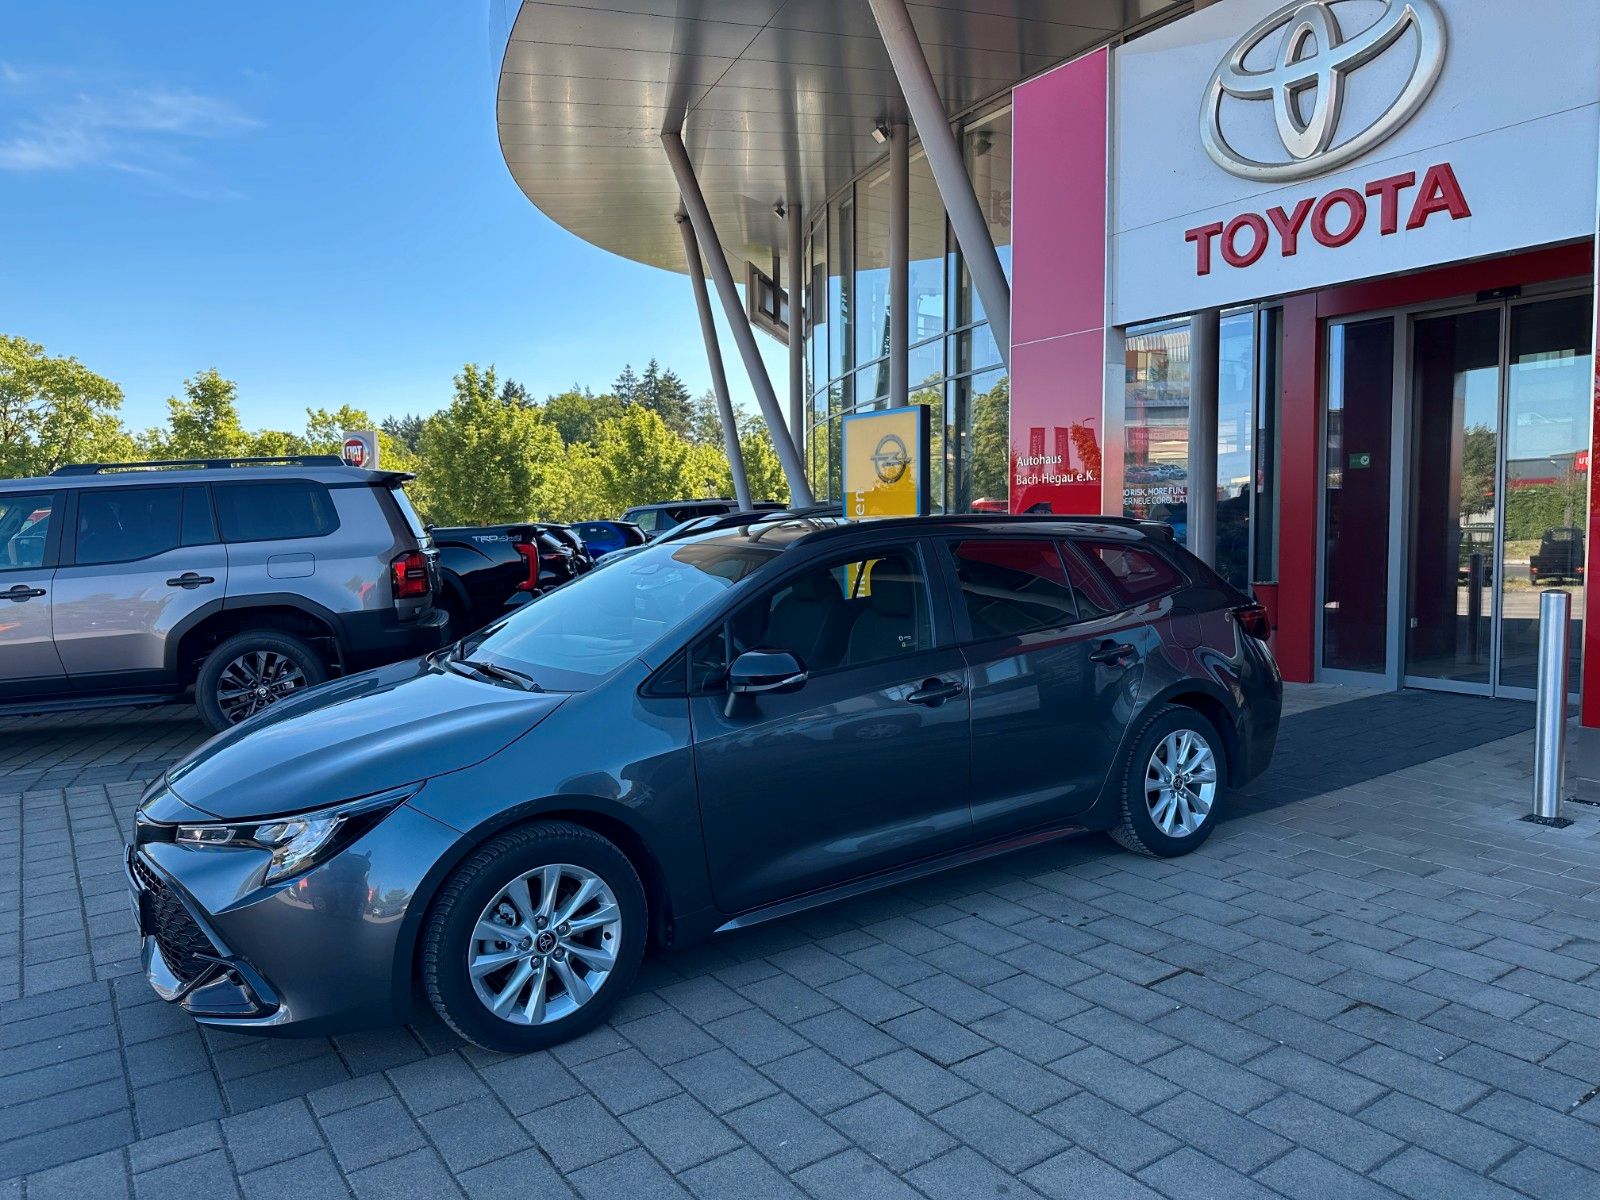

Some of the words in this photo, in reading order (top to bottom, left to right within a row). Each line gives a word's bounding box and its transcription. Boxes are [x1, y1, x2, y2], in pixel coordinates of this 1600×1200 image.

[1185, 163, 1472, 276] TOYOTA
[1016, 454, 1062, 467] Autohaus
[1016, 472, 1074, 486] Bach-Hegau
[1076, 469, 1096, 482] e.K.
[1130, 488, 1147, 497] RISK,
[1148, 487, 1168, 495] MORE
[1168, 486, 1185, 495] FUN.
[1133, 497, 1151, 505] NEUE
